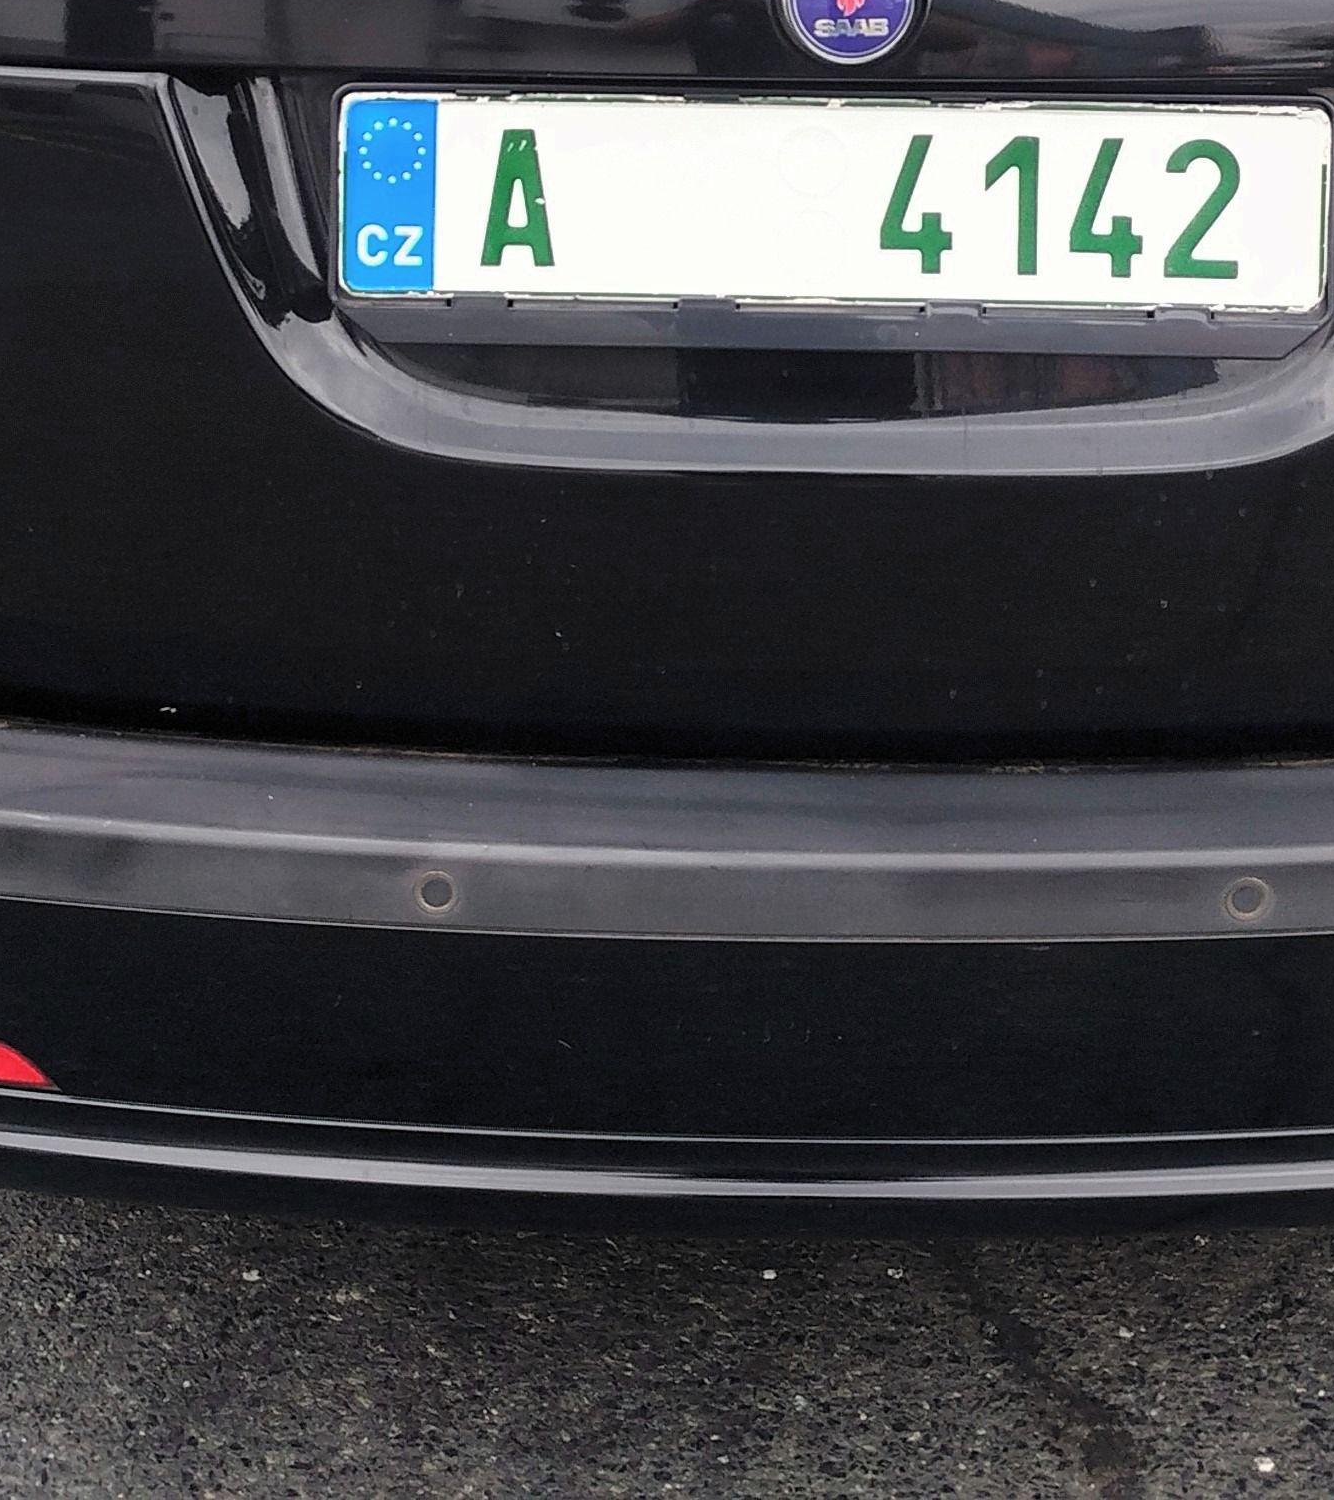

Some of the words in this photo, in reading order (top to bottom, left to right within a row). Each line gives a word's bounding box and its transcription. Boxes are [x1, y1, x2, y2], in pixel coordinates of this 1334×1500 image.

[814, 17, 889, 38] SAAB
[480, 128, 556, 267] A
[880, 134, 1241, 279] 4142
[356, 223, 424, 267] CZ
